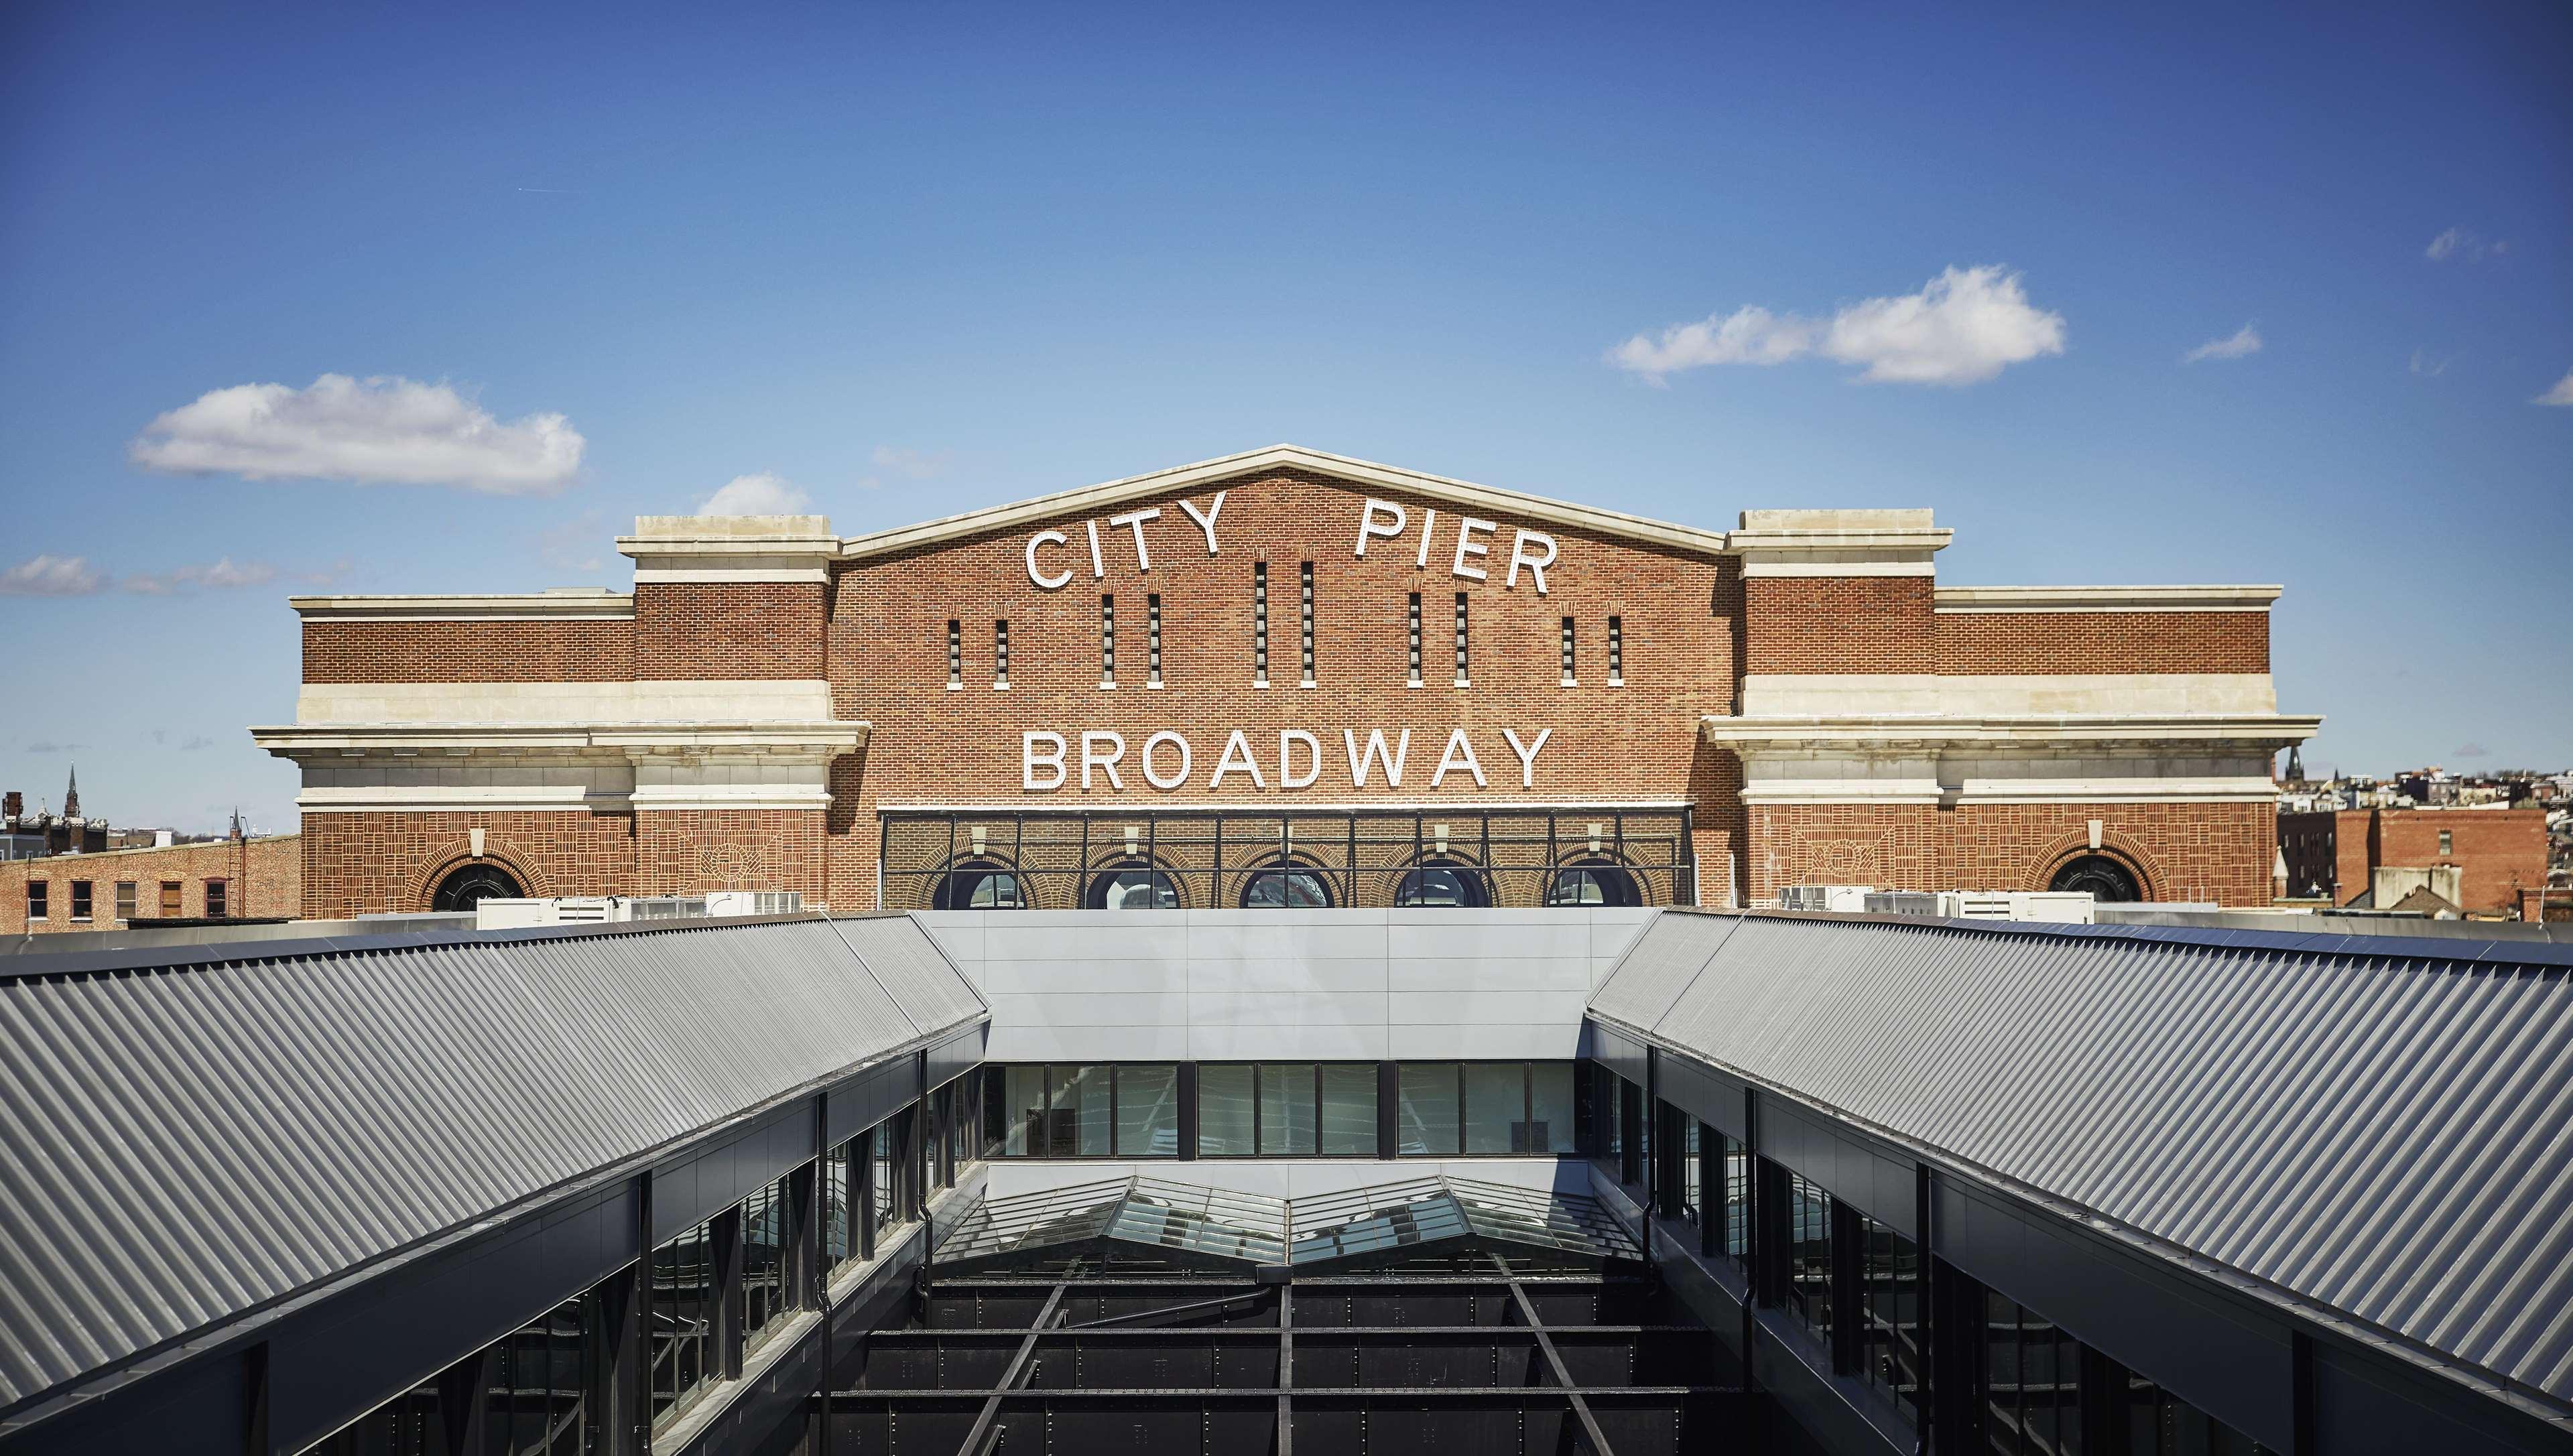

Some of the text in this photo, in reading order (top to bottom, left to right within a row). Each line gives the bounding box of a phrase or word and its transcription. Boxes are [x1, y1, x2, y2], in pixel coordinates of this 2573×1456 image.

[1025, 490, 1558, 594] CITY PIER
[1023, 728, 1553, 789] BROADWAY
